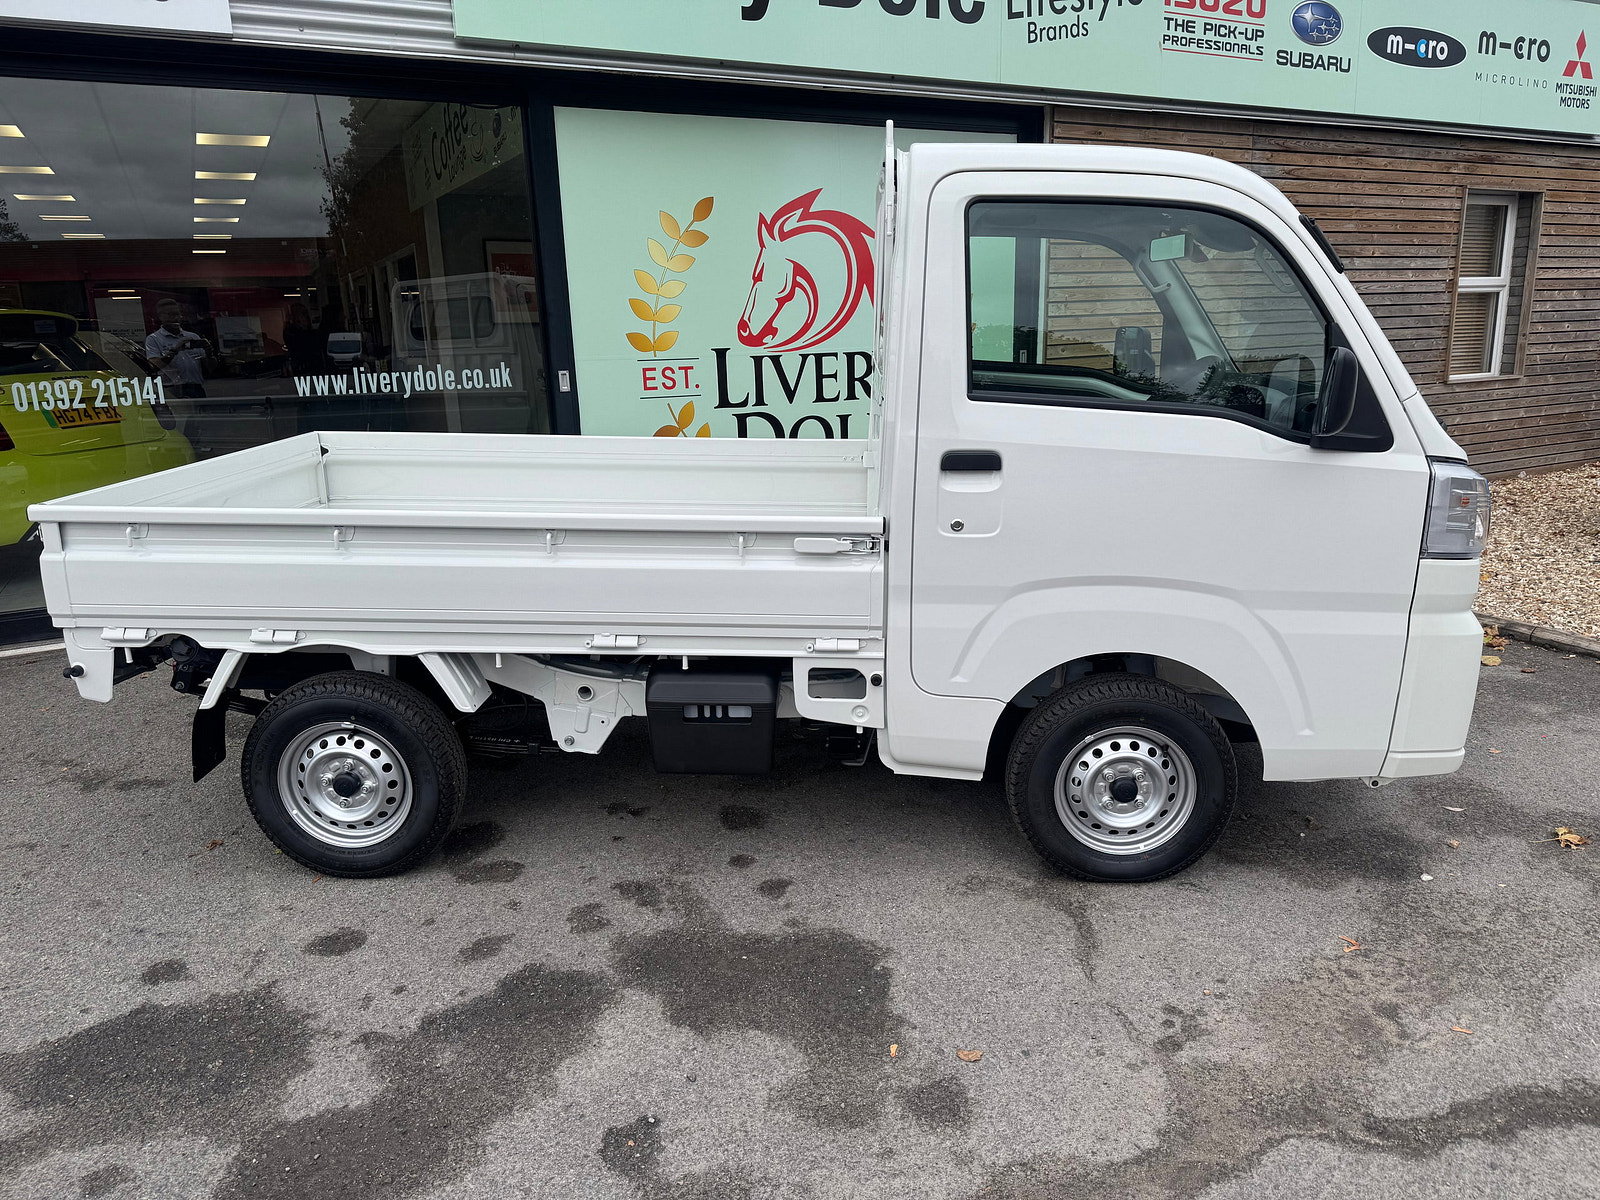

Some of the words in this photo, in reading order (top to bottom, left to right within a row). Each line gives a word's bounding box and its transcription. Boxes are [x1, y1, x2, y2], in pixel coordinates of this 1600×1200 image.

[1027, 14, 1089, 44] Brands
[1163, 16, 1196, 34] THE
[1203, 21, 1265, 42] PICK-UP
[1162, 33, 1264, 56] PROFESSIONALS
[1276, 49, 1351, 73] SUBARU
[1475, 71, 1548, 90] MICROLINO
[1555, 82, 1598, 98] MITSUBISHI
[1559, 96, 1591, 110] MOTORS
[432, 102, 469, 181] Coffee
[293, 361, 513, 399] www.liverydole.co.uk
[642, 366, 700, 391] EST.
[711, 347, 873, 409] LIVER
[11, 380, 87, 412] 01392
[91, 376, 166, 408] 215141
